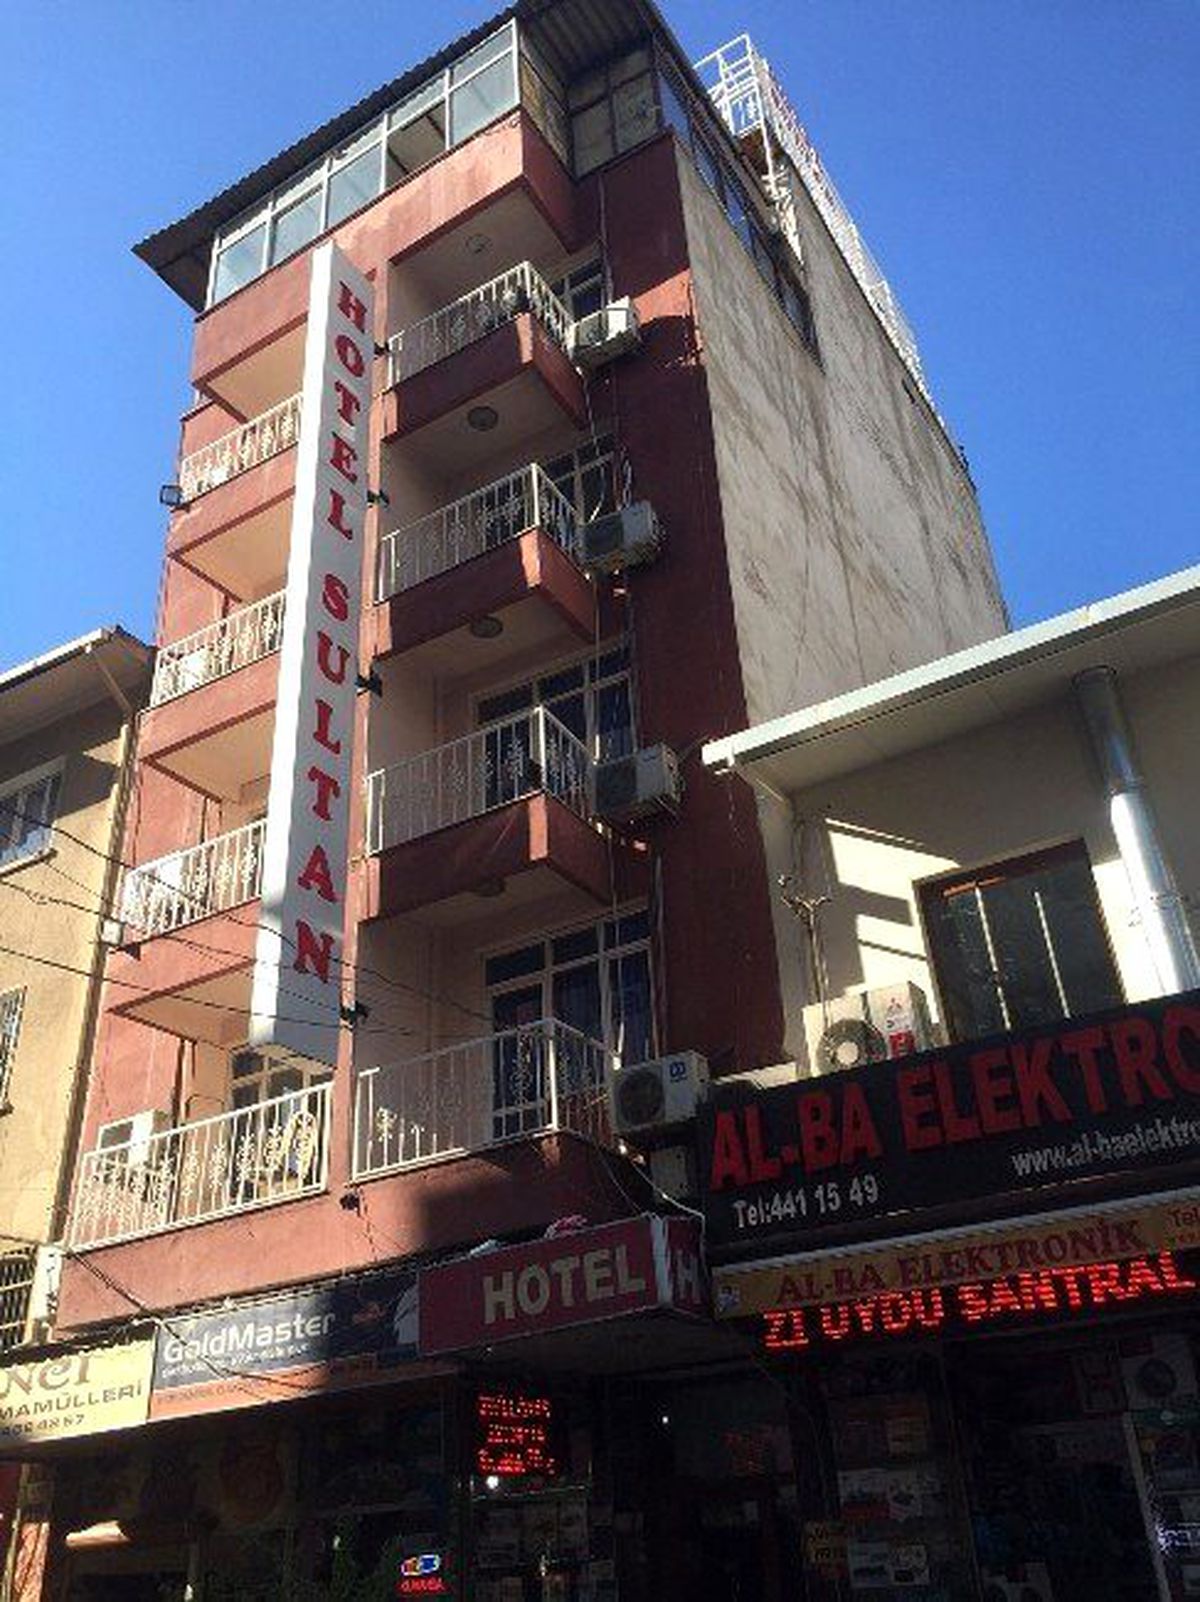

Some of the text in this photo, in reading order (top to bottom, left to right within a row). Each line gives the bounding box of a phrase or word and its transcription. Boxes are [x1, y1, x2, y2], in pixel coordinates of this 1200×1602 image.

[293, 280, 368, 985] HOTEL SULTAN
[709, 1003, 1200, 1192] AL-BA ELEKTRO
[732, 1174, 879, 1229] Tel:441 15 49
[482, 1243, 646, 1325] HOTEL
[777, 1264, 886, 1303] AL-BA
[957, 1249, 1197, 1322] SANTRAL
[163, 1312, 336, 1364] GoldMaster
